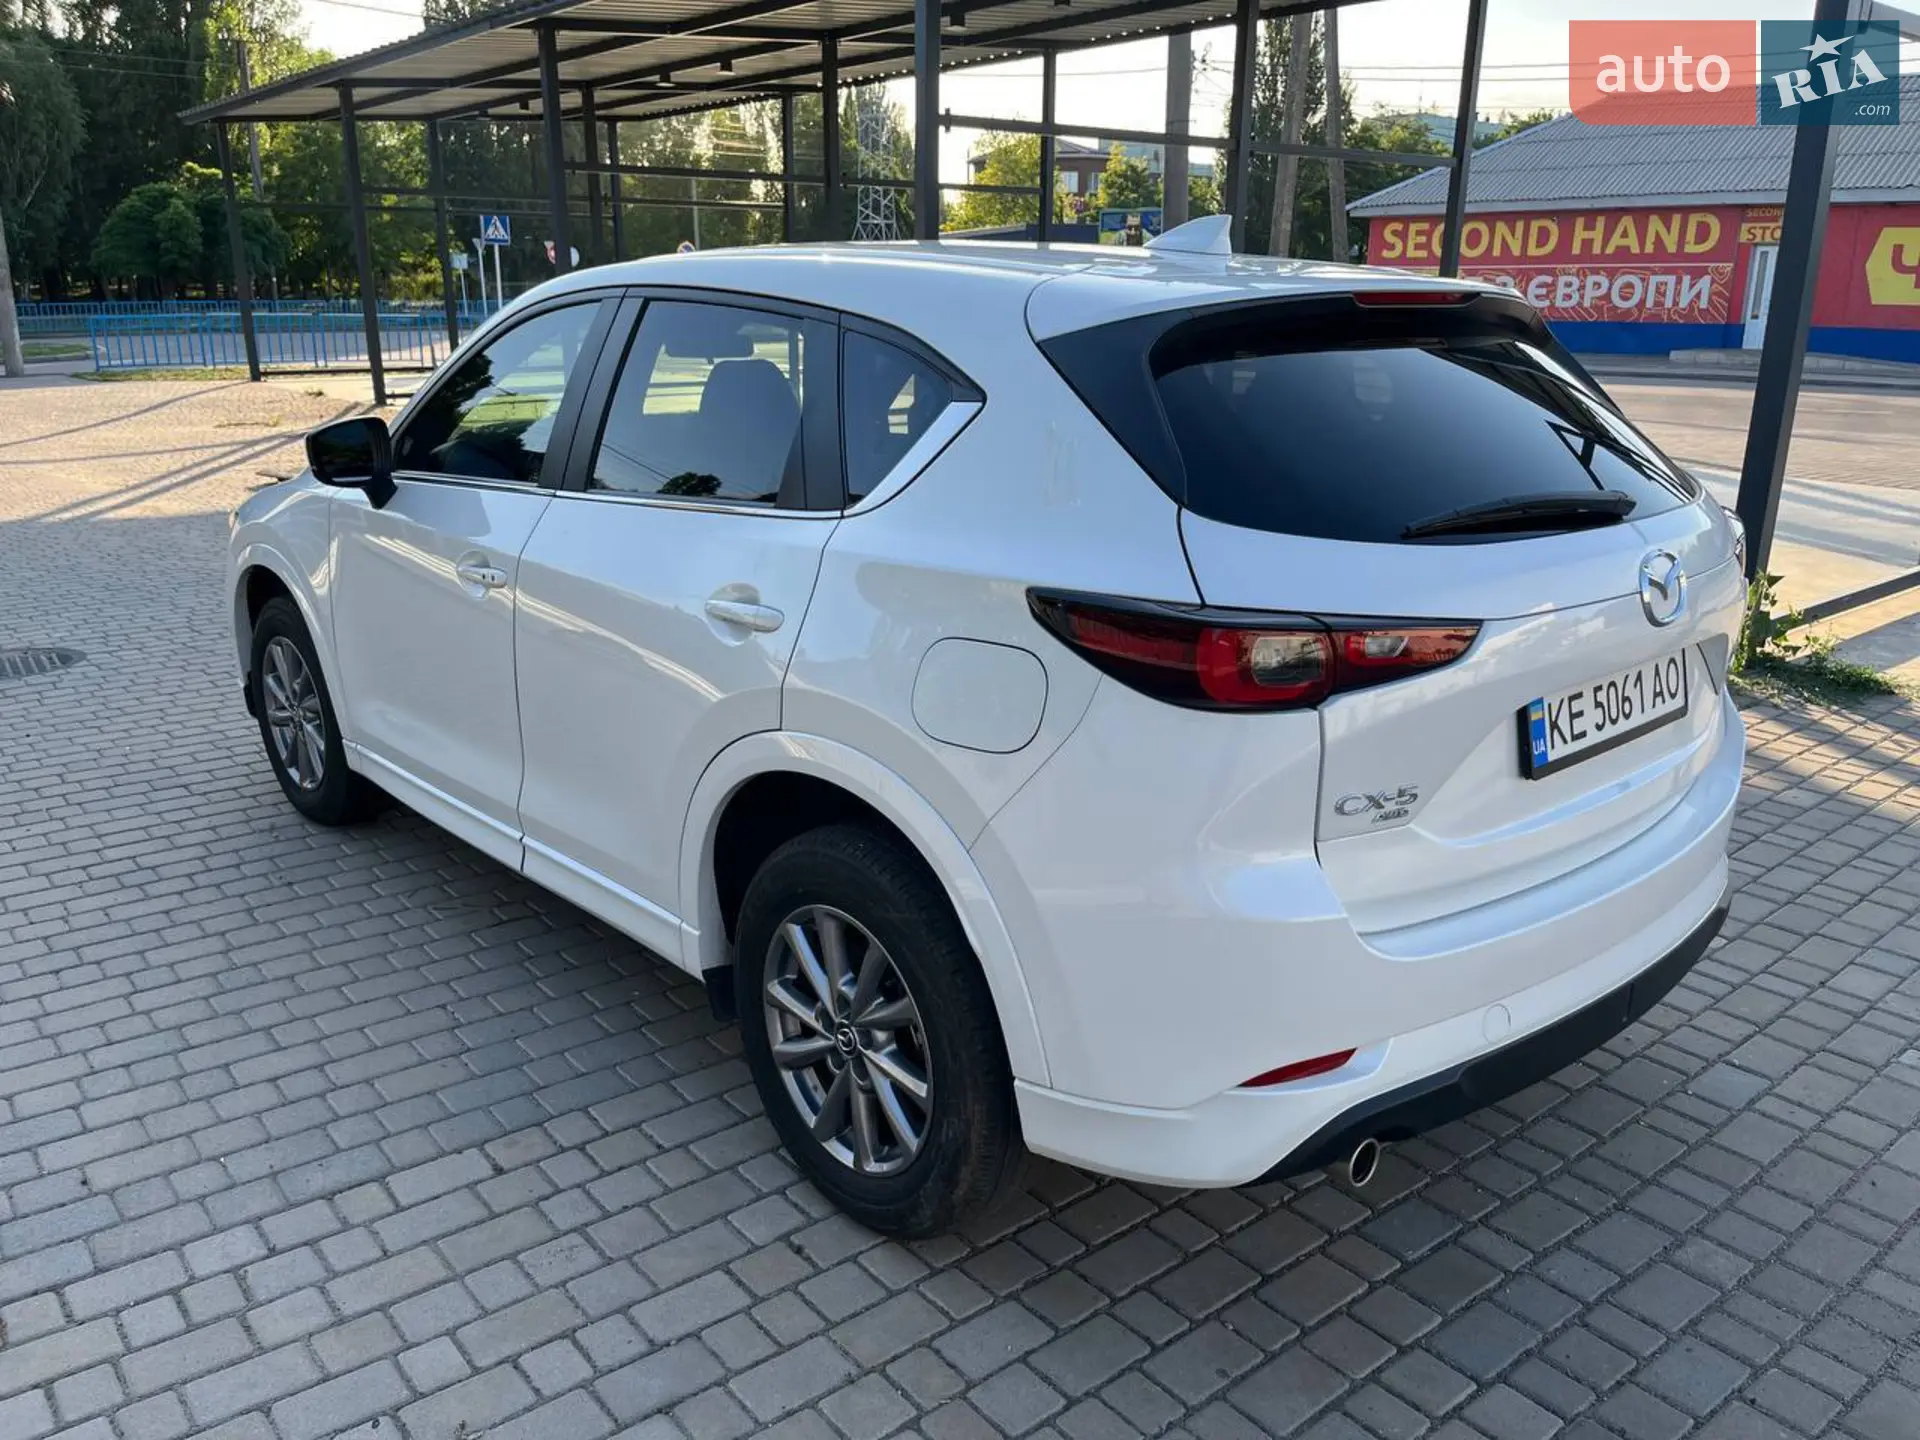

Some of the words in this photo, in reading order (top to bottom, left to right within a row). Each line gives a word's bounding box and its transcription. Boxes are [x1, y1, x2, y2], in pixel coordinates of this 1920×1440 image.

[1571, 212, 1721, 256] HAND
[1527, 273, 1713, 309] ЄВРОПИ
[1548, 691, 1588, 750] KE
[1592, 669, 1645, 732] 5061
[1652, 656, 1680, 709] AO
[1532, 740, 1546, 755] UA
[1334, 783, 1418, 816] CX-5
